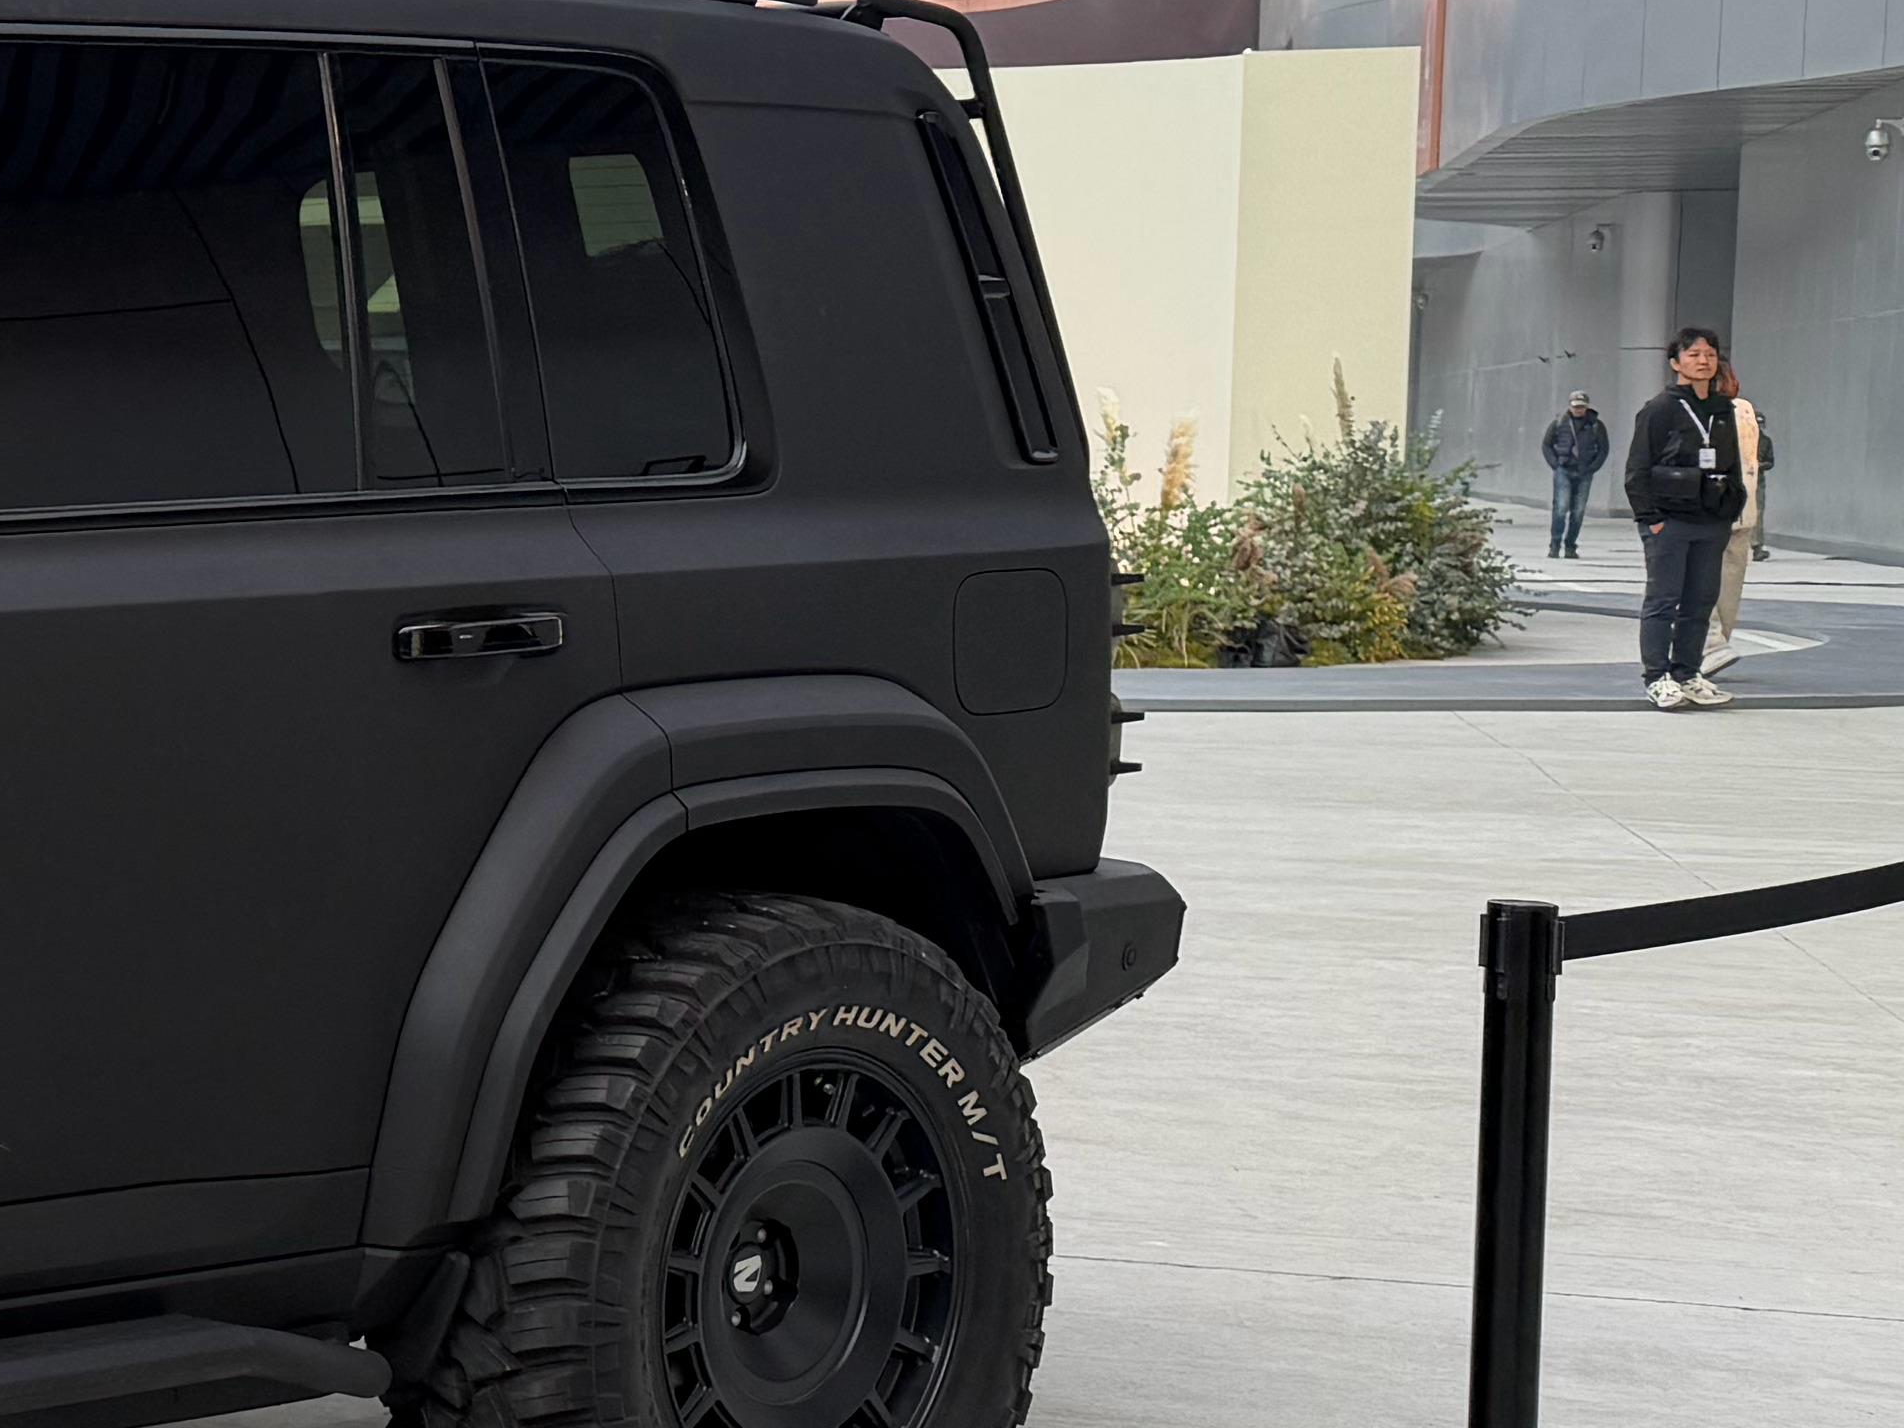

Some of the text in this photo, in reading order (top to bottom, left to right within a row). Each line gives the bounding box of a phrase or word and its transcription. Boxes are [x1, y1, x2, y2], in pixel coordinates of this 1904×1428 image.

[679, 1005, 1008, 1181] COUNTRY HUNTER M/T
